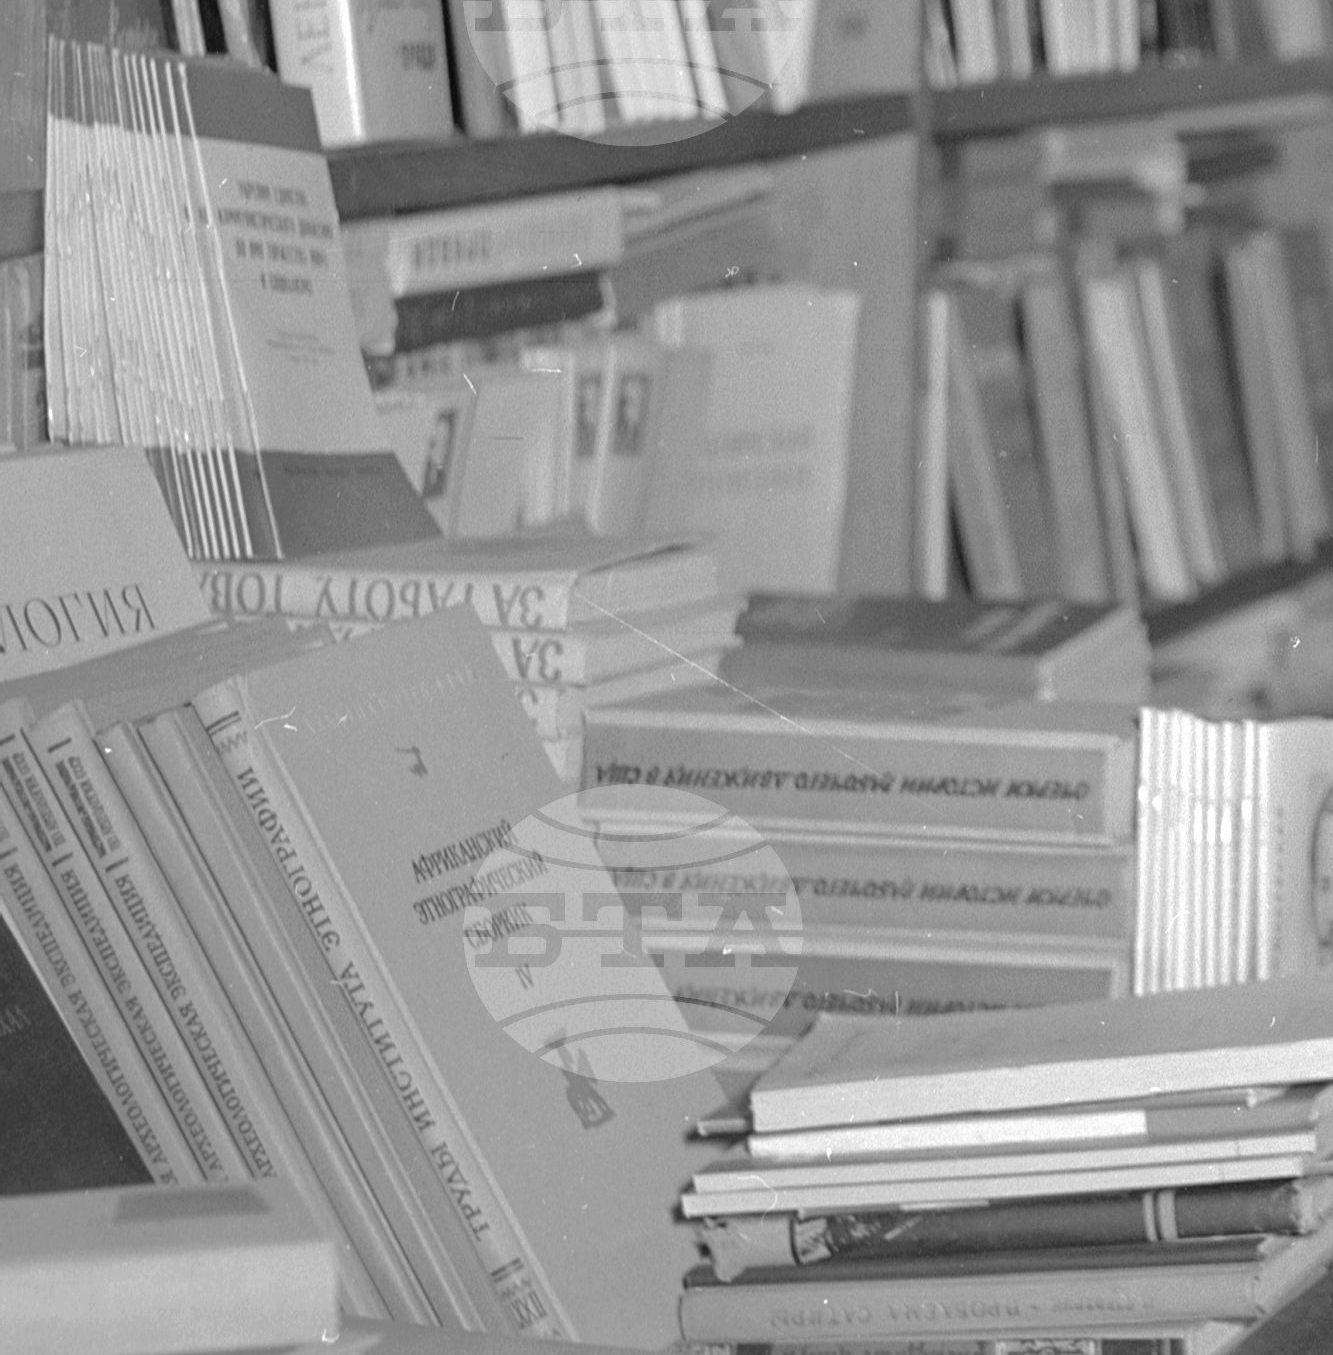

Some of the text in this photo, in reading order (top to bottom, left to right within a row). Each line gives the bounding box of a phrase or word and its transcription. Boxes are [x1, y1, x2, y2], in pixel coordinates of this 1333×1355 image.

[493, 583, 545, 629] ЗА
[509, 637, 563, 682] ЗА
[595, 761, 642, 783] США
[646, 766, 660, 784] В
[662, 764, 790, 788] ДВИЖЕНИЯ
[406, 816, 518, 884] АФРИКАНСКИЙ
[411, 849, 549, 926] ЭТНОГРАФИЧЕСКИЙ
[3, 861, 77, 987] ЭКСПЕДИЦИЯ
[60, 867, 133, 995] ЭКСПЕДИЦИЯ
[114, 872, 279, 1182] АРХЕОЛОГИЧЕСКАЯ ЭКСПЕДИЦИЯ
[233, 764, 494, 1242] ТРУДЫ ИНСТИТУТА ЭТНОГРАФИИ
[67, 988, 167, 1167] АРХЕОЛОГИЧЕСКАЯ
[123, 994, 223, 1174] АРХЕОЛОГИЧЕСКАЯ
